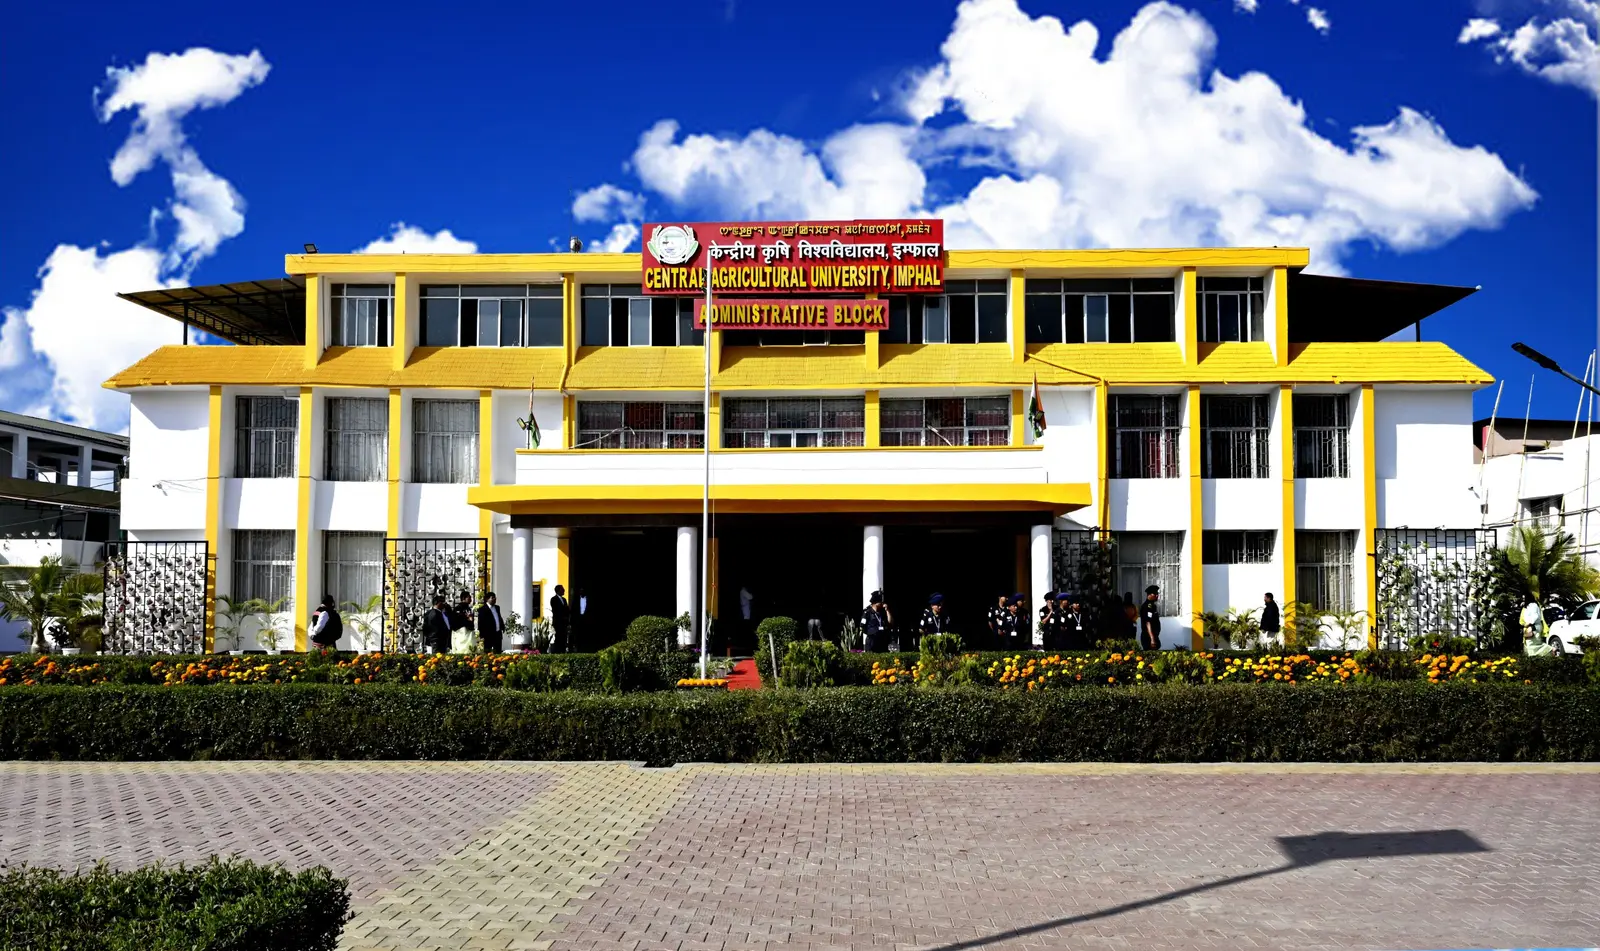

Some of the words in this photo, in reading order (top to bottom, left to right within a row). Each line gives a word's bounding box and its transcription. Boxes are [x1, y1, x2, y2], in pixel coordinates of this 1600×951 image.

[708, 240, 756, 260] केन्द्रीय
[760, 240, 792, 264] कृषि
[797, 239, 889, 260] विश्वविद्यालय,
[892, 242, 941, 260] इम्फाल
[711, 265, 807, 288] AGRICULTURAL
[810, 265, 891, 290] UNIVERSITY,
[893, 264, 941, 287] IMPHAL
[699, 303, 825, 324] ADMINISTRATIVE
[833, 304, 884, 324] BLOCK
